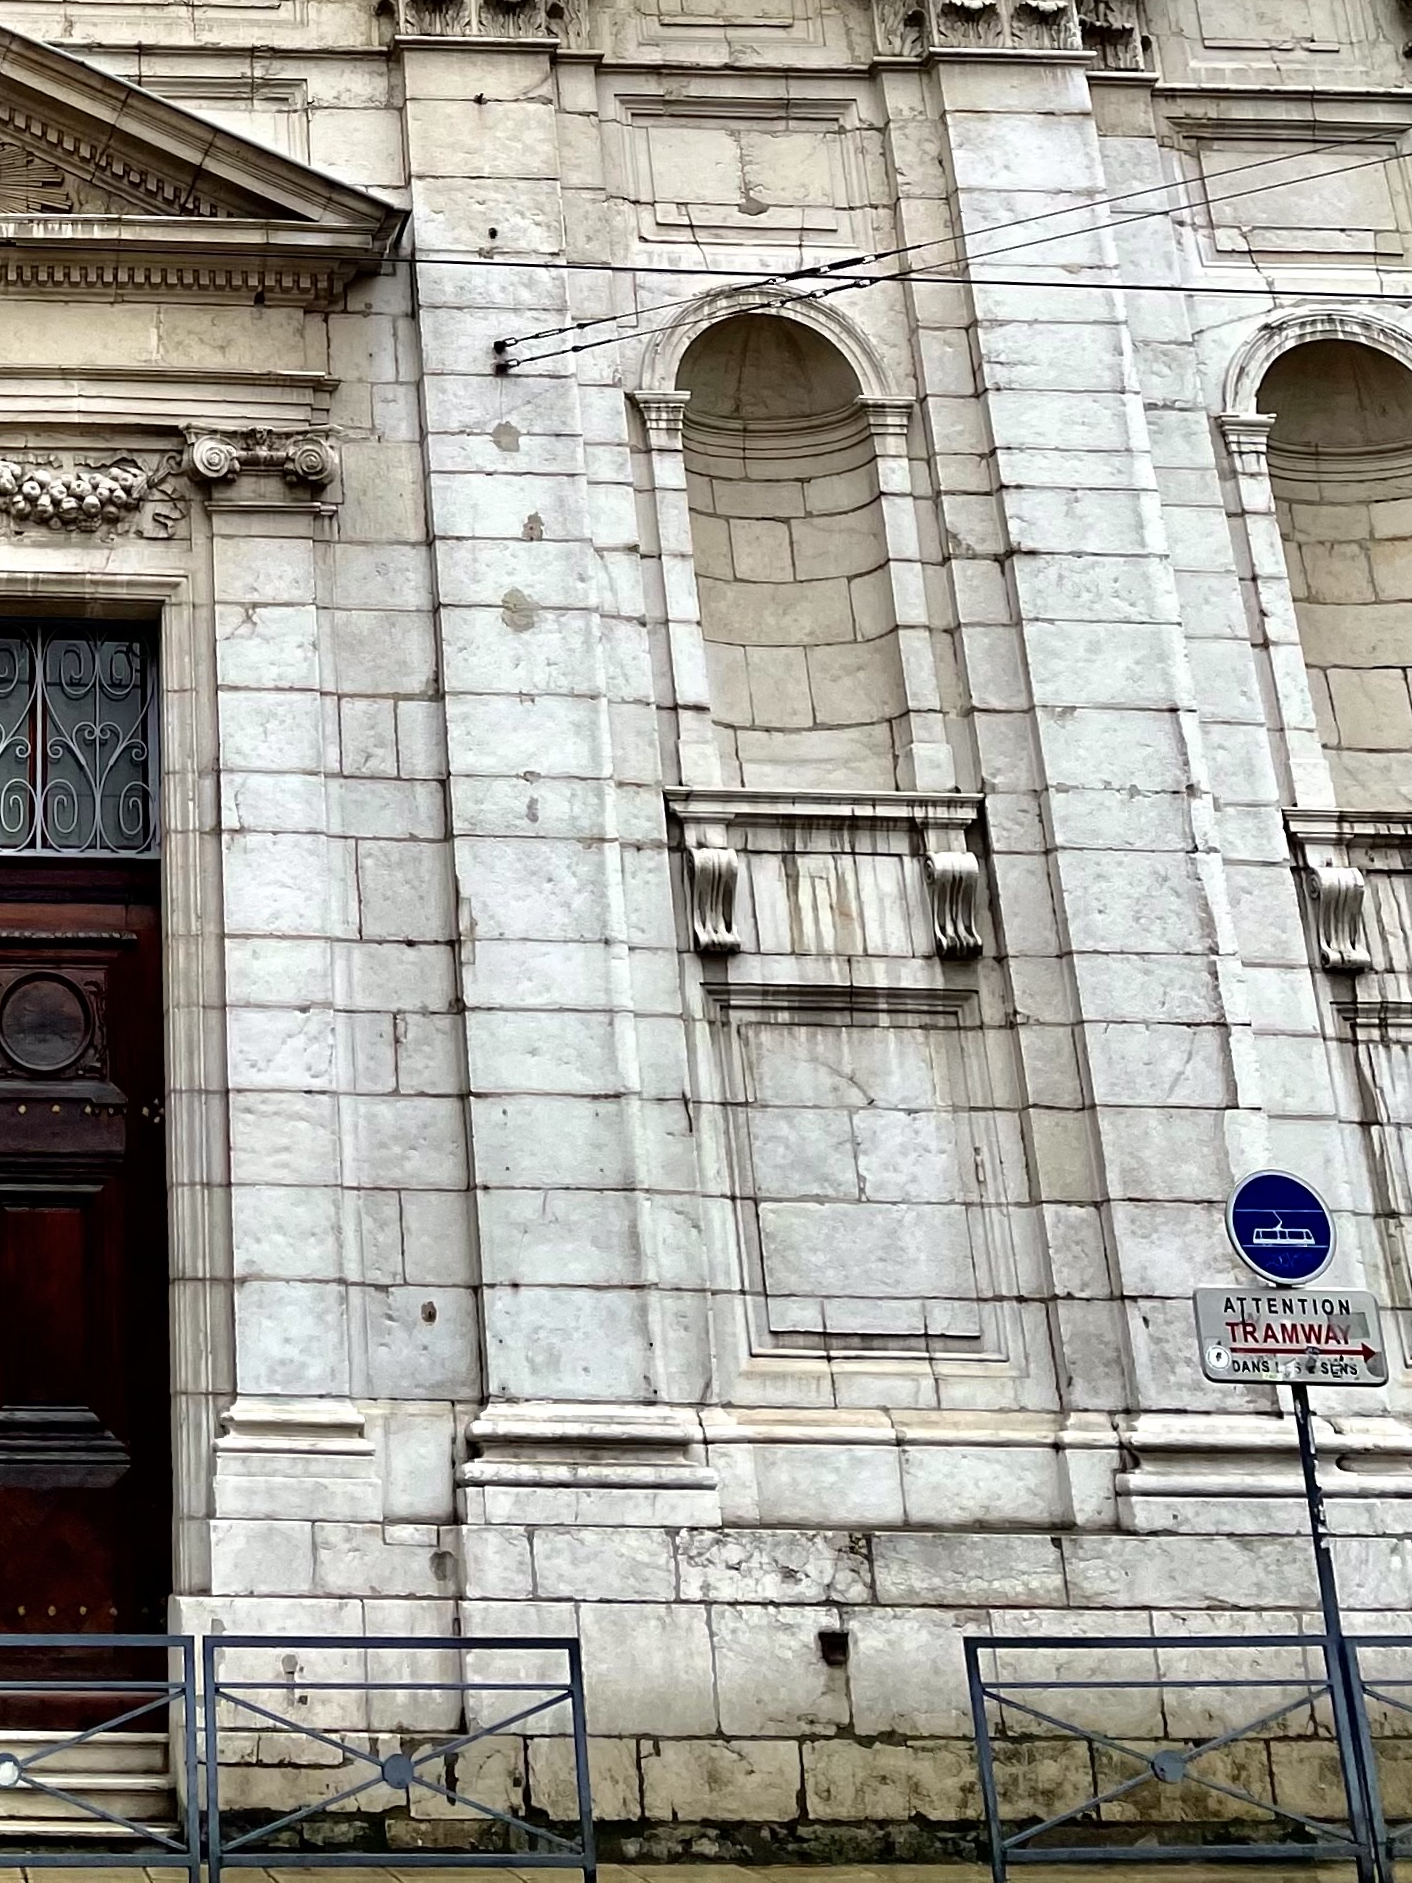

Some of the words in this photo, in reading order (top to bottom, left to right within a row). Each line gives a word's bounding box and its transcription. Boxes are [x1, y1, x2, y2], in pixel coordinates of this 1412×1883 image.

[1224, 1297, 1350, 1315] ATTENTION
[1225, 1322, 1351, 1345] TRAMWAY
[1232, 1360, 1269, 1373] DANS
[1321, 1362, 1358, 1376] SENS
